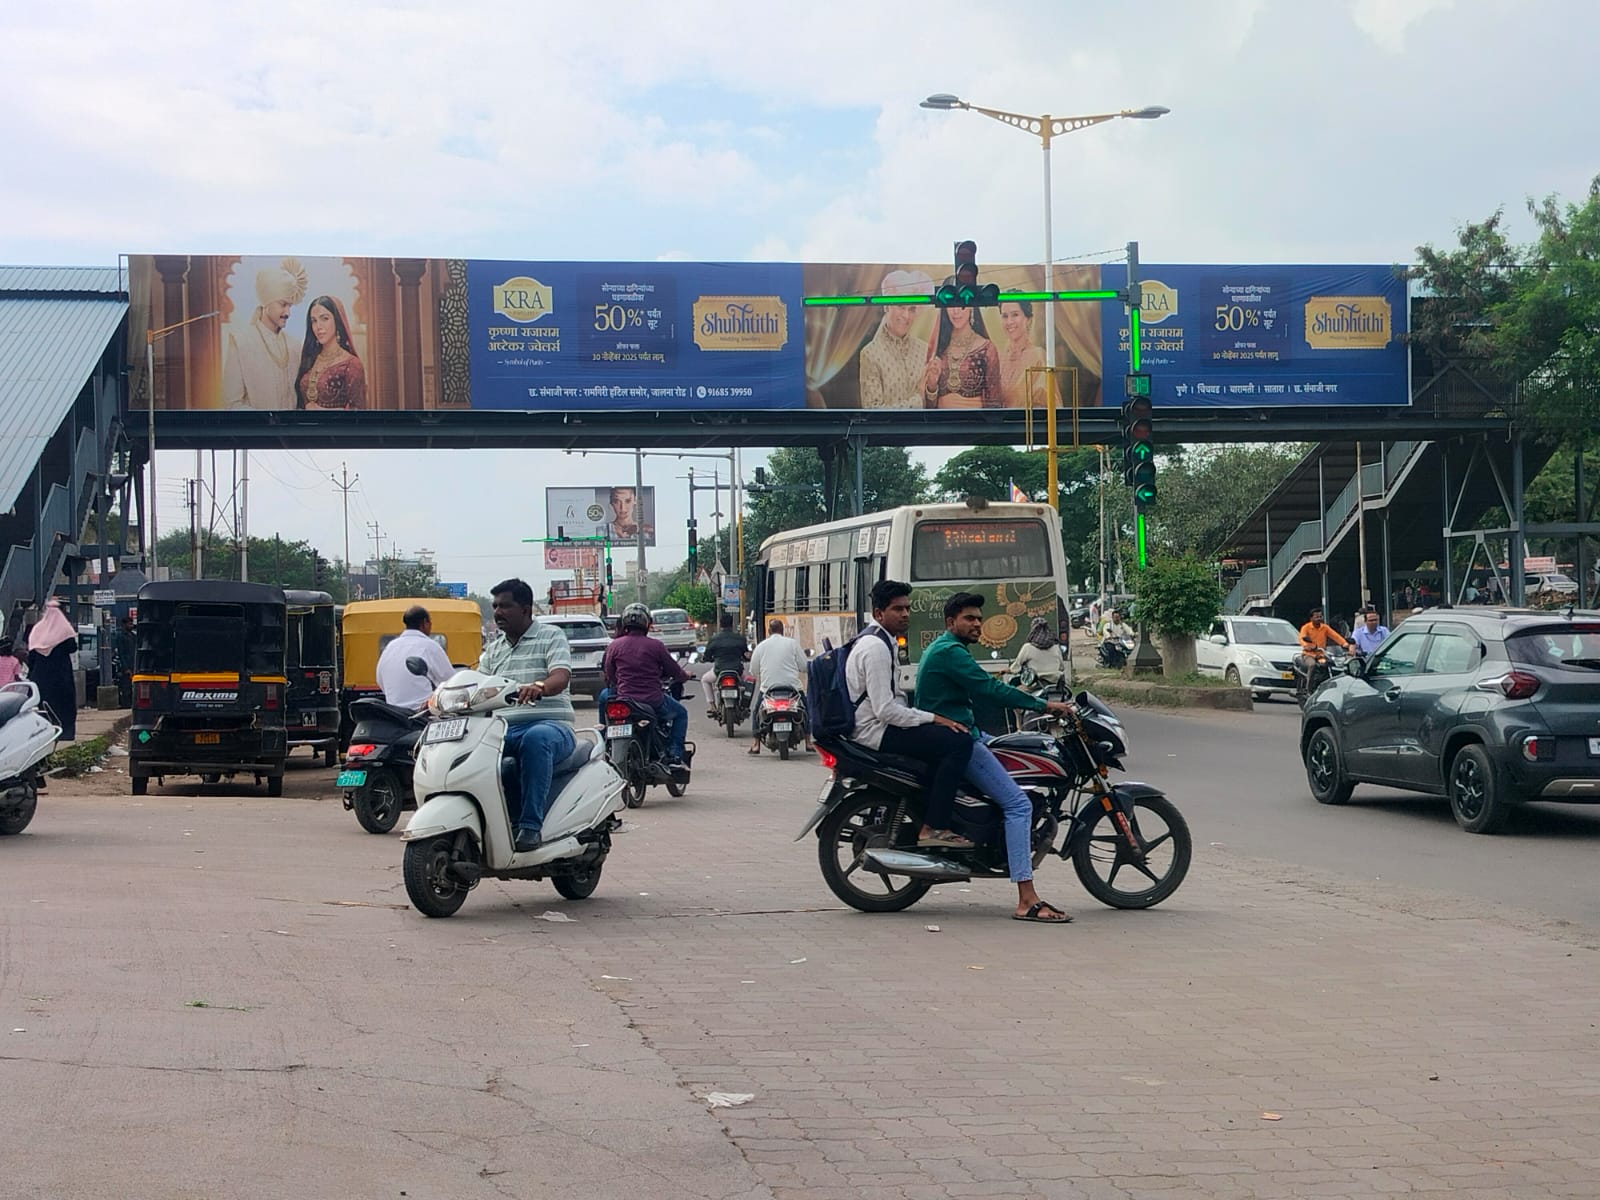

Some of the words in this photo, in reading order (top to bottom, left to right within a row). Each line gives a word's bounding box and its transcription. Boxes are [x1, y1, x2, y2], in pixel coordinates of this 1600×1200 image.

[503, 290, 544, 309] KRA
[647, 319, 658, 330] सूट
[700, 303, 778, 336] Shubhtithi
[1312, 303, 1384, 335] Shubhtithi
[488, 327, 518, 340] कृष्णा
[520, 327, 560, 337] राजाराम
[1149, 328, 1183, 338] राजाराम
[488, 339, 526, 352] अष्टेकर
[527, 339, 561, 352] ज्वेलर्स
[1154, 339, 1185, 352] ज्वेलर्स
[539, 386, 562, 397] संभाजी
[583, 386, 608, 397] रामगिरी
[650, 388, 674, 397] जालना
[674, 386, 687, 397] रोड
[707, 387, 729, 397] 91685
[730, 387, 753, 397] 39950
[1175, 383, 1188, 397] पुणे
[1325, 384, 1338, 393] नगर
[181, 691, 239, 701] Maxima
